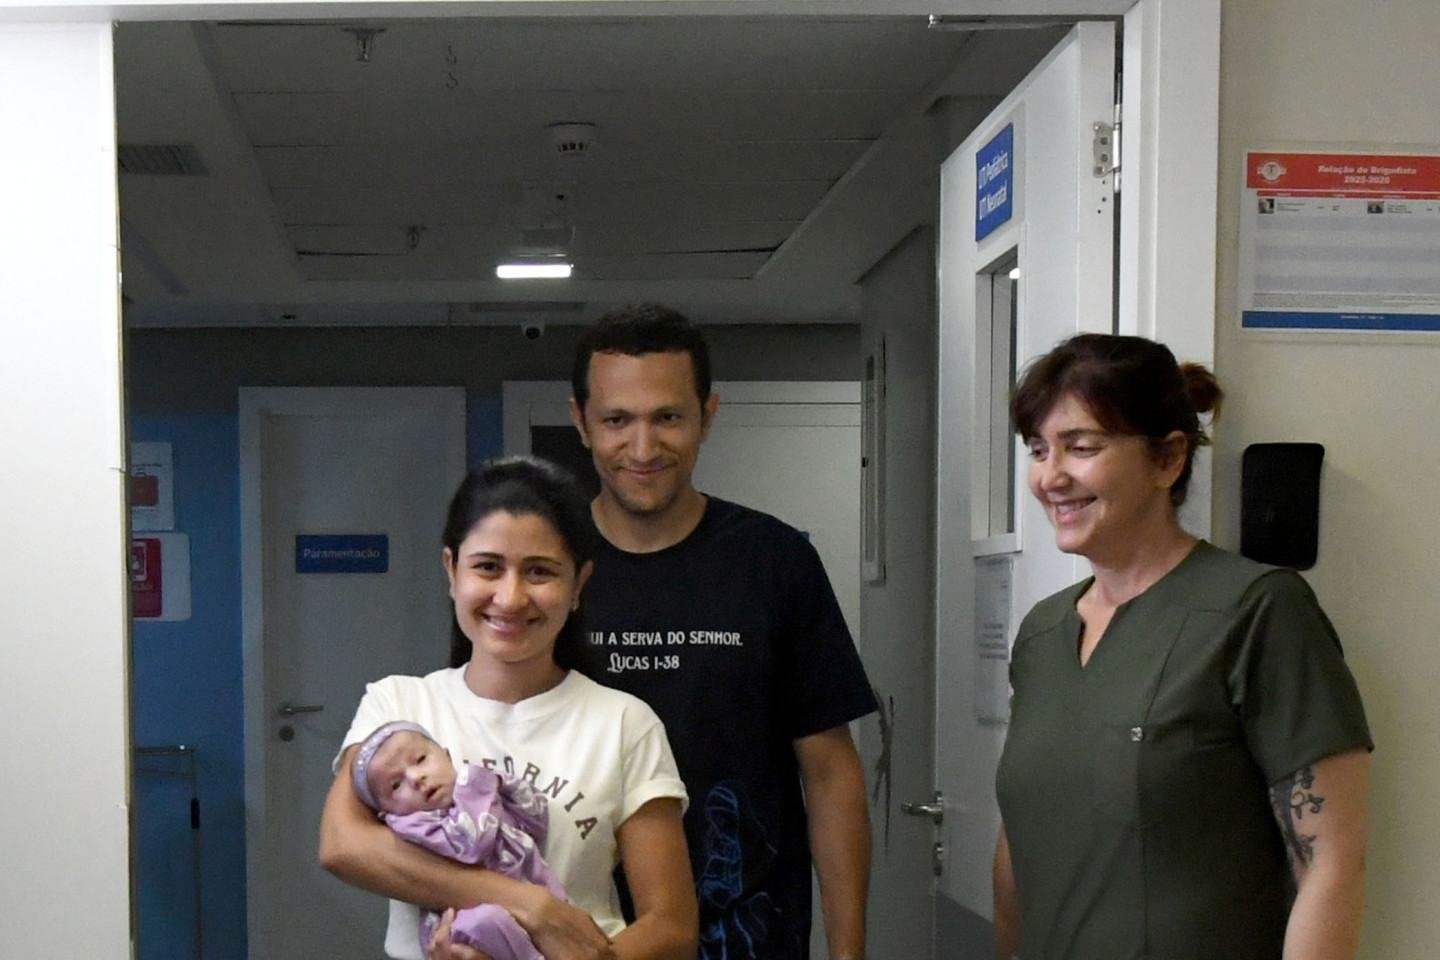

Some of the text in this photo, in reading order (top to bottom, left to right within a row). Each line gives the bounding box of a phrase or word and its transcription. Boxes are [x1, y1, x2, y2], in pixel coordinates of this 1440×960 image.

[303, 548, 381, 560] Paramentação
[607, 632, 618, 645] A
[622, 632, 663, 646] SERVA
[667, 631, 685, 645] DO
[689, 631, 744, 646] SENHOR.
